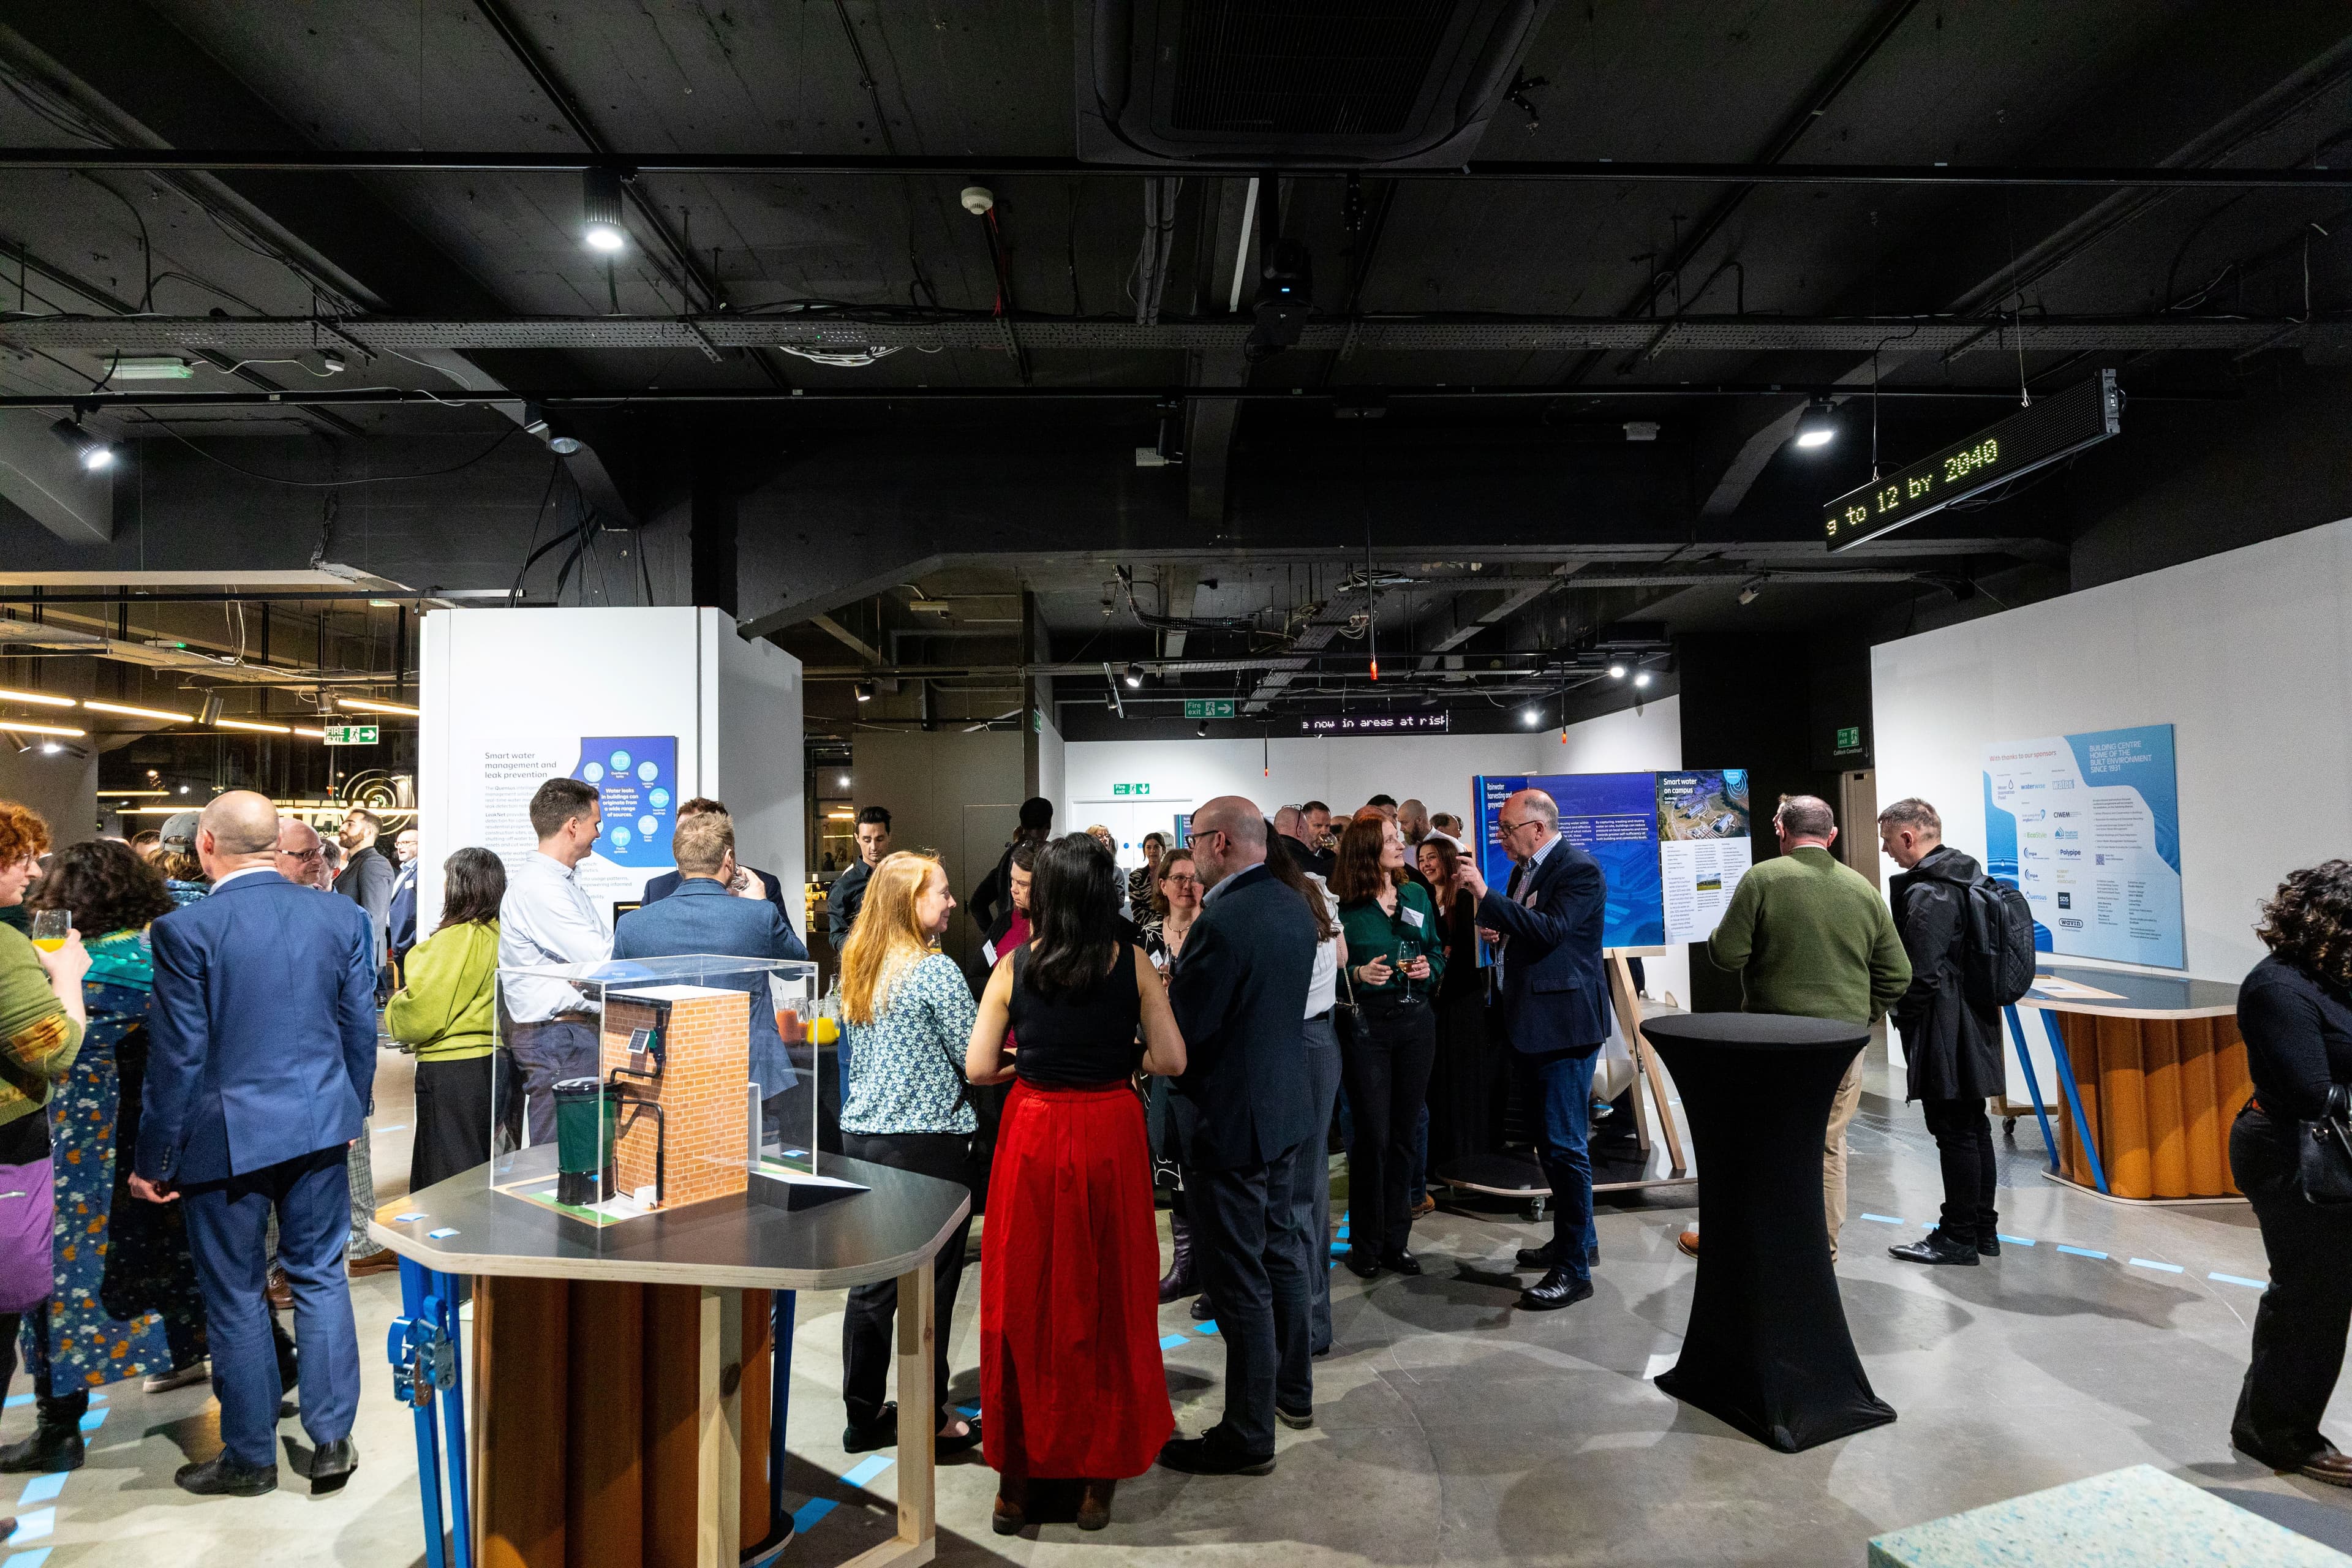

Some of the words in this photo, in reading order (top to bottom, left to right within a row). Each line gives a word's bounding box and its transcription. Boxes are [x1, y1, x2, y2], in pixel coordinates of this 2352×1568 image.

[1845, 507, 1867, 526] to
[1877, 486, 1899, 513] 12
[1908, 473, 1933, 499] by
[1943, 439, 1999, 483] 2040
[1343, 718, 1354, 727] in
[1360, 718, 1393, 727] areas
[1400, 717, 1414, 726] at
[2089, 743, 2117, 752] BUILDING
[2117, 741, 2142, 749] CENTRE
[2034, 750, 2057, 759] sponsors
[2090, 751, 2108, 760] HOME
[2107, 754, 2152, 764] ENVIRONMENT
[1487, 791, 1506, 800] harvesting
[2025, 891, 2047, 900] Quensus
